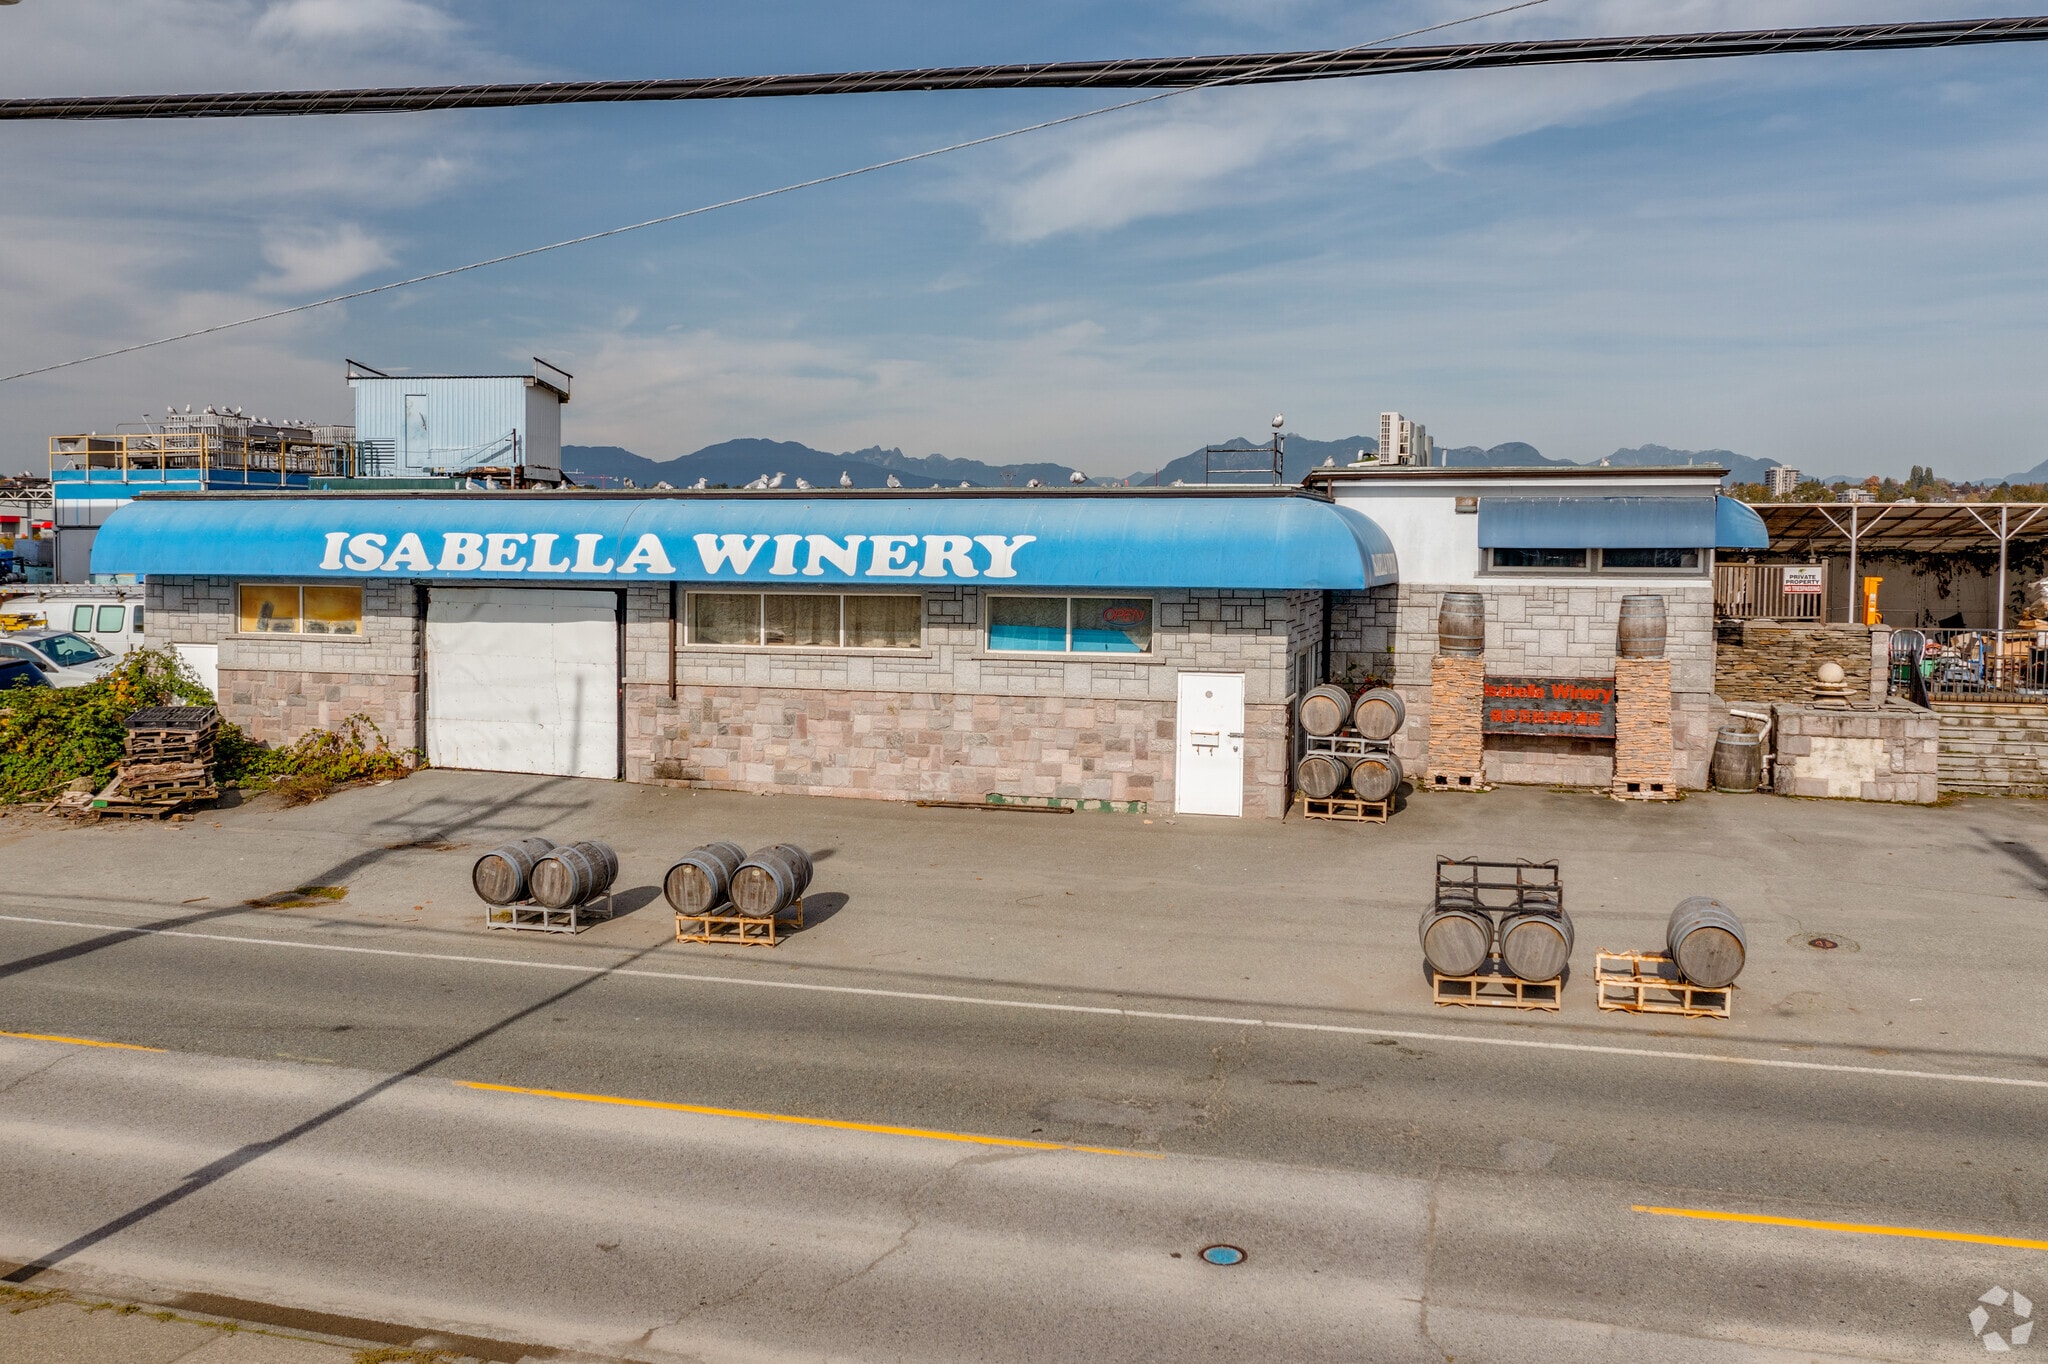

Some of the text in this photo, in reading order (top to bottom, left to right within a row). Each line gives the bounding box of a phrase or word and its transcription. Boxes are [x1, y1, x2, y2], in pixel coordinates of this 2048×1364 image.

[319, 532, 1037, 578] ISABELLA WINERY
[1103, 607, 1146, 622] OPEN
[1484, 683, 1613, 705] Isabella Winery
